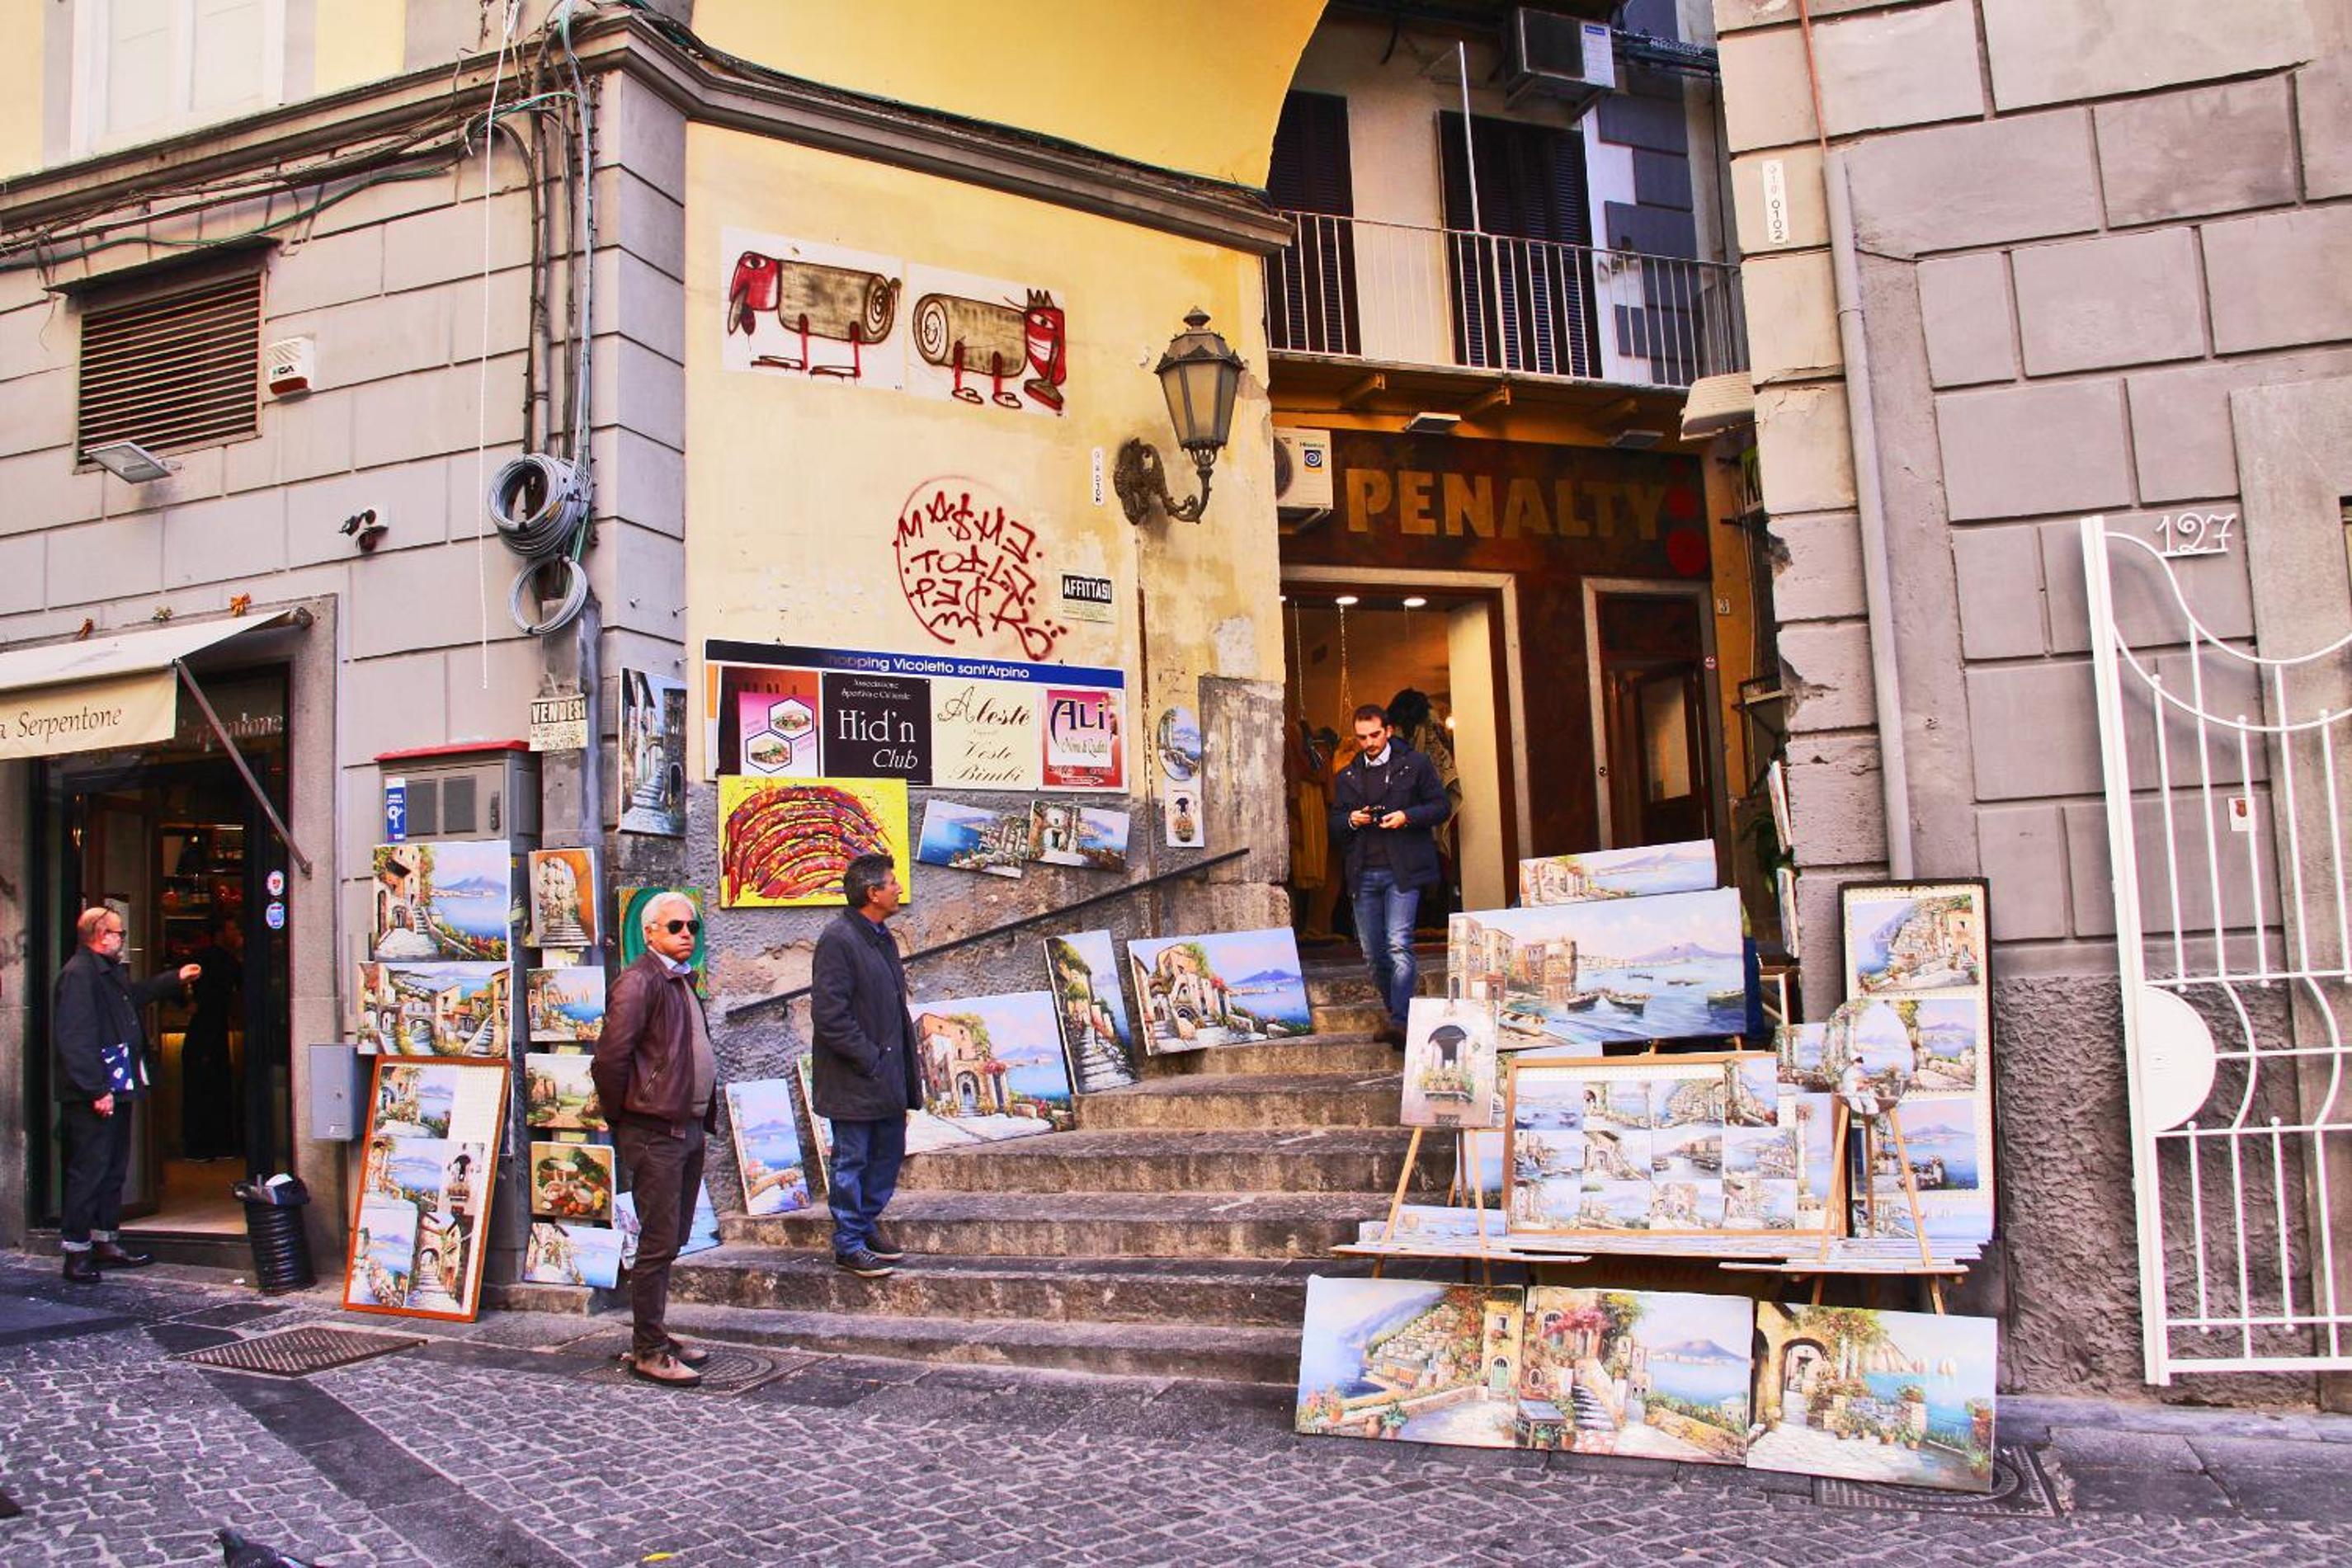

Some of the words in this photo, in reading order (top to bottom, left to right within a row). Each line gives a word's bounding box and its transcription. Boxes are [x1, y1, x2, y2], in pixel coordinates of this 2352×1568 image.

[1345, 468, 1666, 541] PENALTY
[2156, 512, 2237, 554] 127
[1063, 577, 1111, 600] AFFITTASI
[827, 655, 890, 672] hopping
[893, 658, 954, 673] Vicoletto
[958, 665, 1030, 682] sant'Arpino
[17, 705, 121, 744] Serpentone
[532, 699, 586, 724] VENDESI
[838, 709, 916, 743] Hid'n
[873, 748, 918, 770] Club
